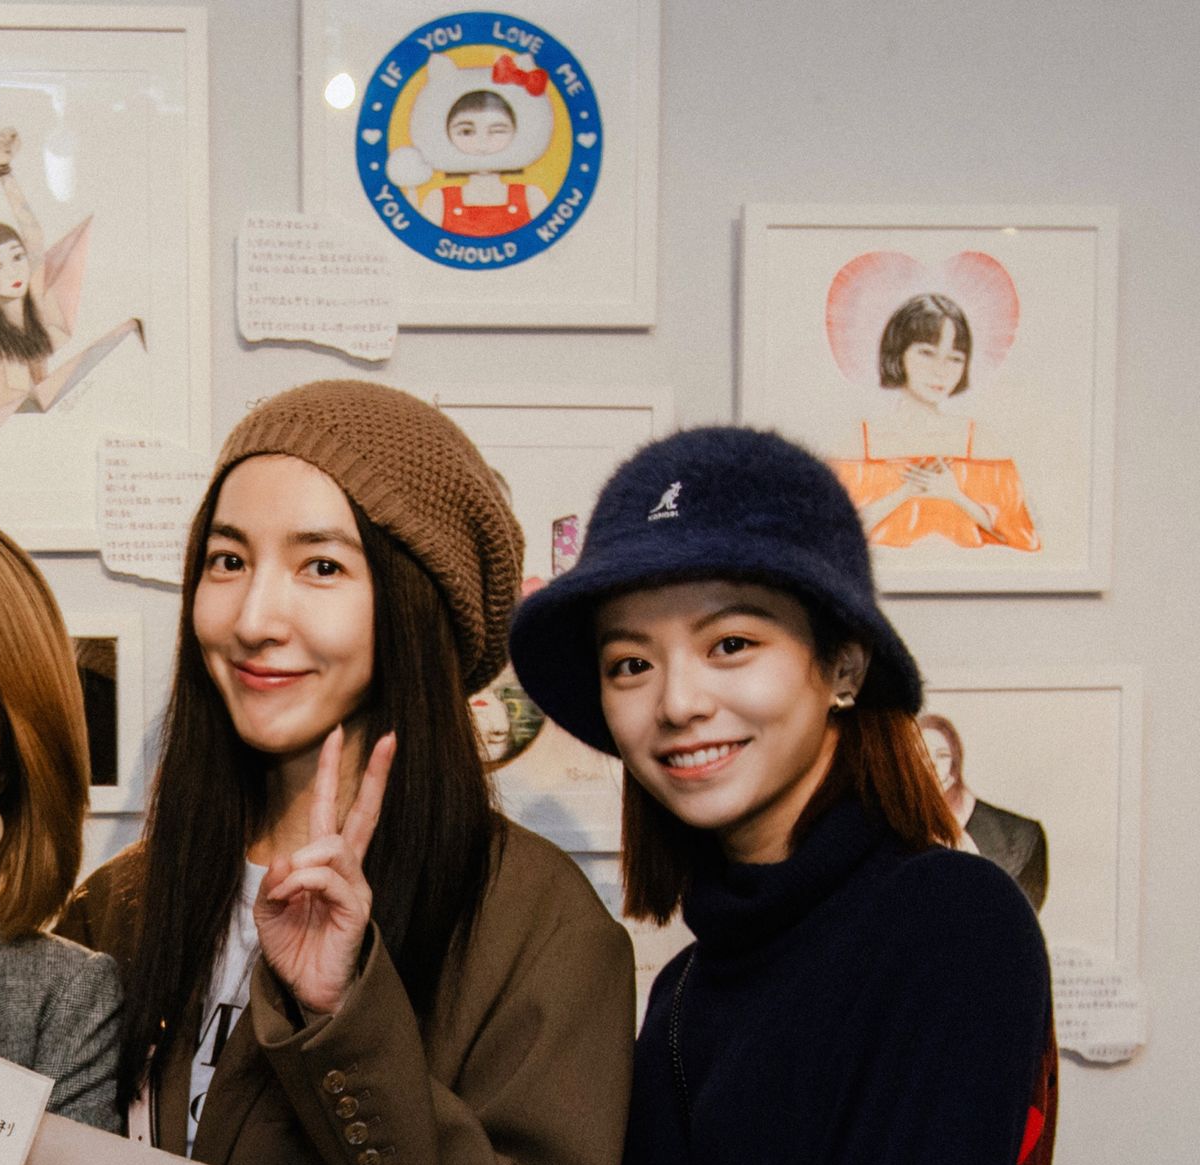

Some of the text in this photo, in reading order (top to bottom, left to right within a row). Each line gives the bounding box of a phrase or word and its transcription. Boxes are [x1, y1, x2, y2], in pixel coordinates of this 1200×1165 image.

[380, 21, 585, 97] IF YOU LOVE ME
[375, 185, 410, 230] YOU
[435, 238, 517, 264] SHOULD
[536, 188, 583, 242] KNOW
